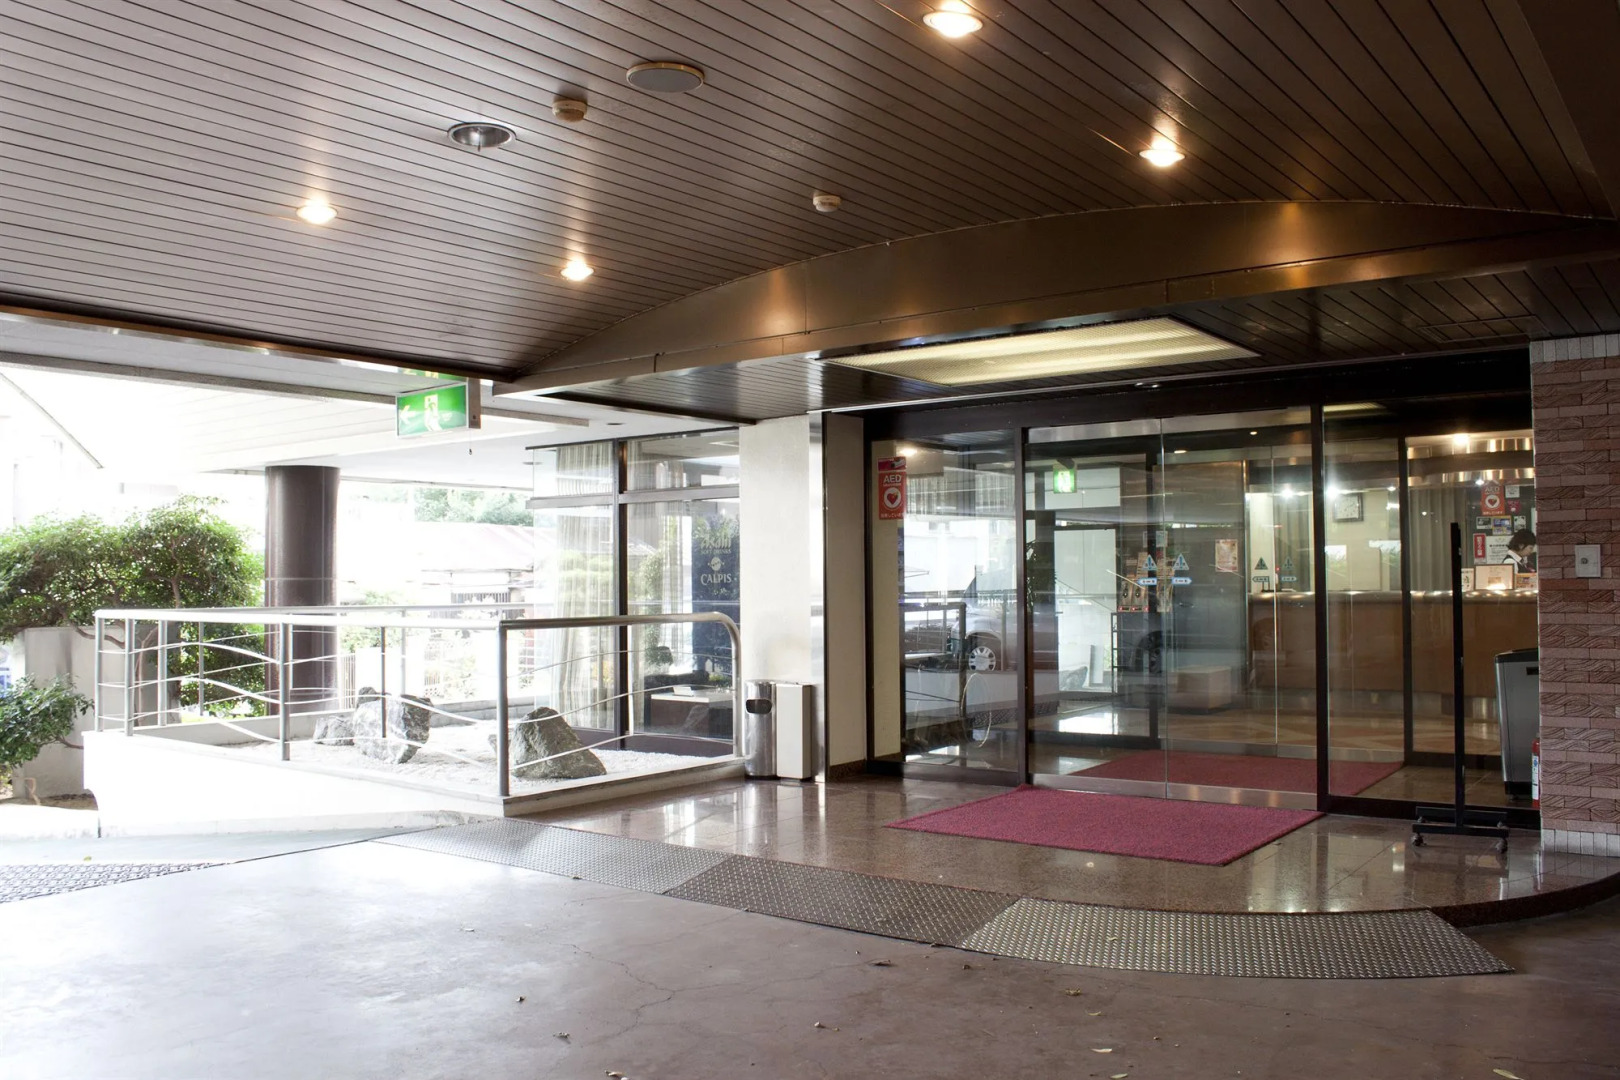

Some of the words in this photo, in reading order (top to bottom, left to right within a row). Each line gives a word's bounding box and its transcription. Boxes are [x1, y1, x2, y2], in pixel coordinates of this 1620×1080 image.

[883, 474, 902, 482] AED
[701, 532, 732, 549] Asahi
[701, 573, 732, 585] CALPIS
